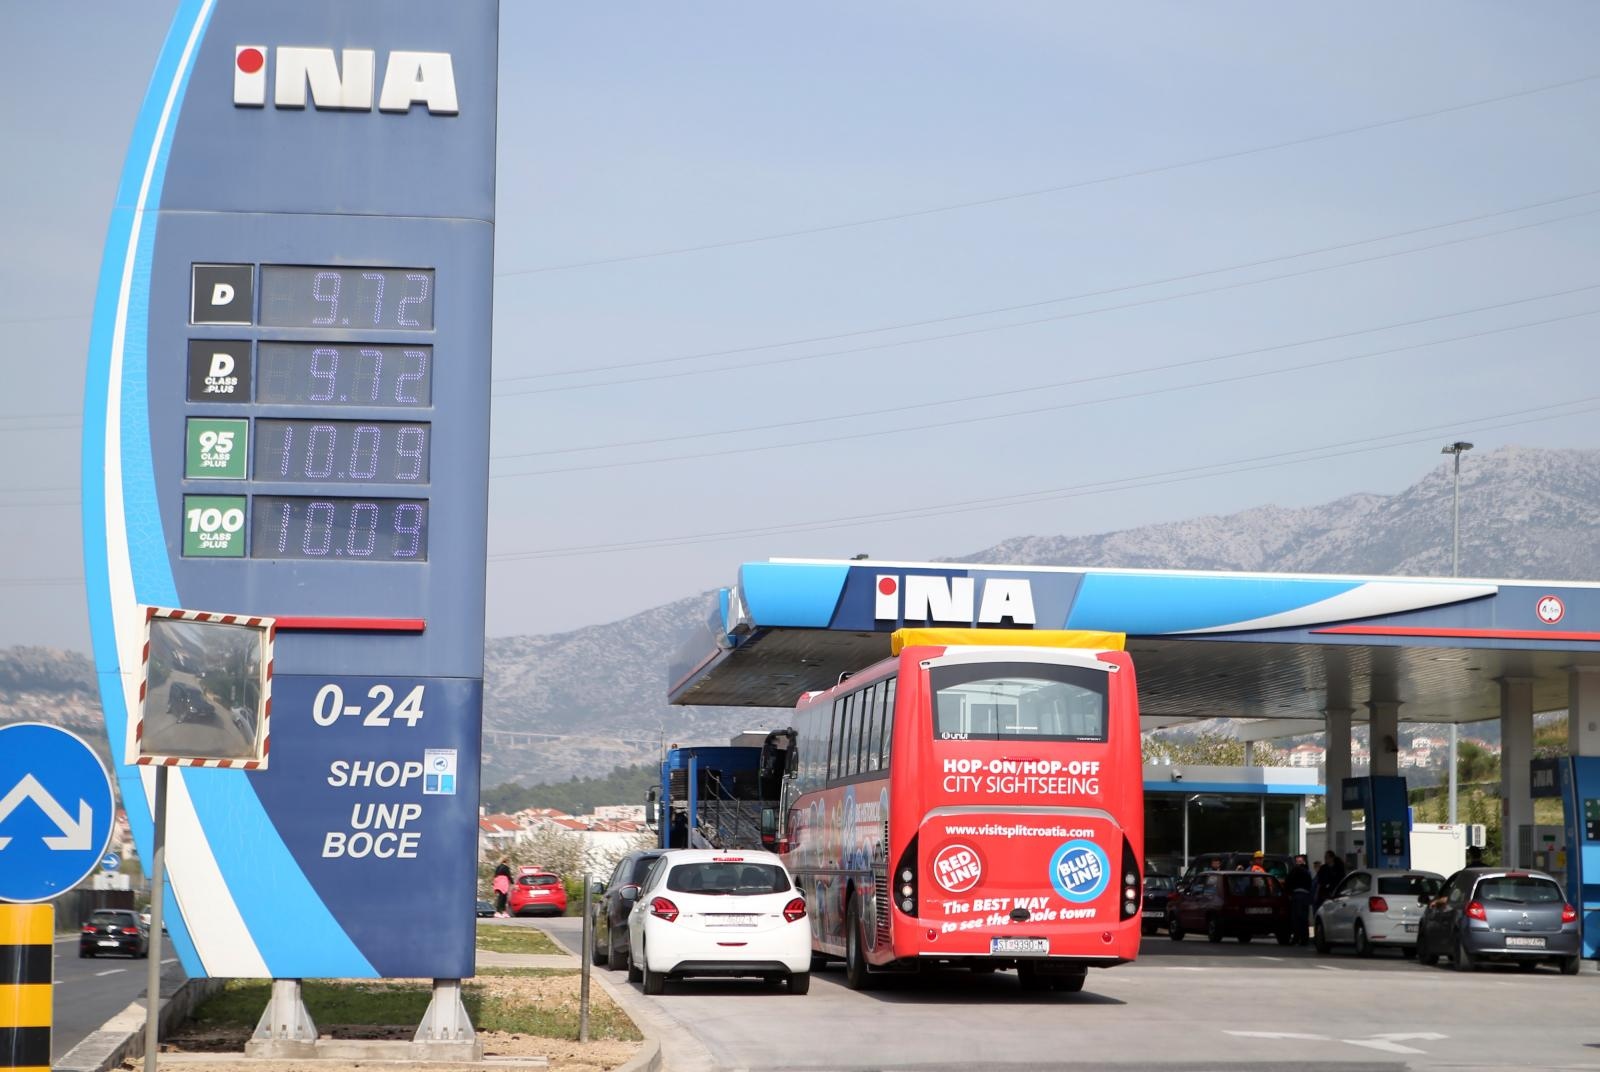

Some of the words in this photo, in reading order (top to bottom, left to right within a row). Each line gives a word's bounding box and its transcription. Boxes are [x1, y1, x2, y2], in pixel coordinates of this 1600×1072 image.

[211, 283, 235, 305] D
[312, 272, 429, 326] 9.72
[209, 353, 235, 377] D
[310, 349, 427, 403] 9.72
[205, 377, 238, 386] CLASS
[205, 385, 235, 394] PLUS
[199, 431, 235, 453] 95
[281, 426, 425, 479] 10.09
[201, 453, 231, 461] CLASS
[202, 460, 228, 468] PLUS
[187, 508, 244, 533] 100
[278, 503, 424, 557] 10.09
[200, 533, 232, 541] CLASS
[202, 540, 229, 549] PLUS
[313, 684, 425, 726] 0-24
[327, 761, 424, 787] SHOP
[943, 759, 1100, 776] HOP-ON/HOP-OFF
[943, 776, 982, 793] CITY
[986, 776, 1099, 795] SIGHTSEEING
[351, 803, 422, 829] UNP
[945, 824, 1095, 838] www.visitsplitcroatia.com
[322, 832, 421, 858] BOCE
[938, 851, 971, 874] RED
[1059, 852, 1096, 876] BLUE
[942, 863, 979, 888] LINE
[1063, 864, 1100, 889] LINE
[943, 902, 969, 915] The
[973, 898, 1010, 911] BEST
[1013, 897, 1050, 910] WAY
[942, 922, 957, 933] to
[960, 917, 983, 930] see
[986, 913, 1010, 926] the
[1013, 909, 1056, 923] hole
[1060, 907, 1096, 919] town
